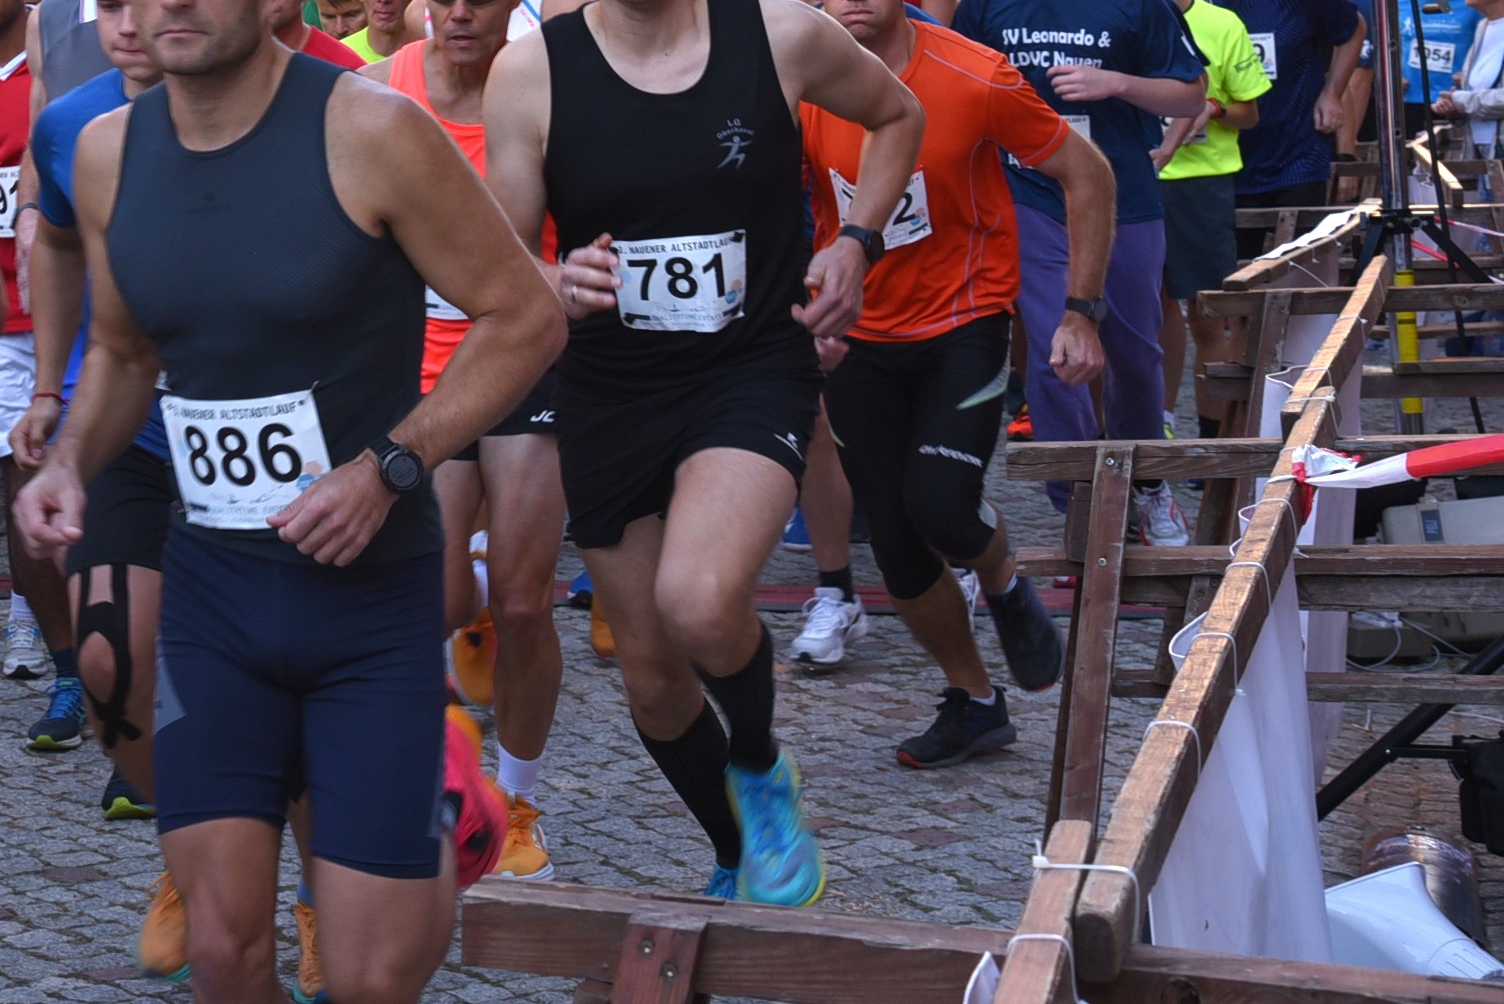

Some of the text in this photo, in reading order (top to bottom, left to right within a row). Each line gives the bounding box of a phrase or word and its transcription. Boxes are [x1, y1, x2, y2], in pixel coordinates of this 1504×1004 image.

[1002, 27, 1112, 47] SV Leonardo &
[1010, 50, 1050, 68] LDVC
[629, 244, 667, 255] NAUENER
[627, 252, 726, 301] 781
[184, 422, 303, 487] 886
